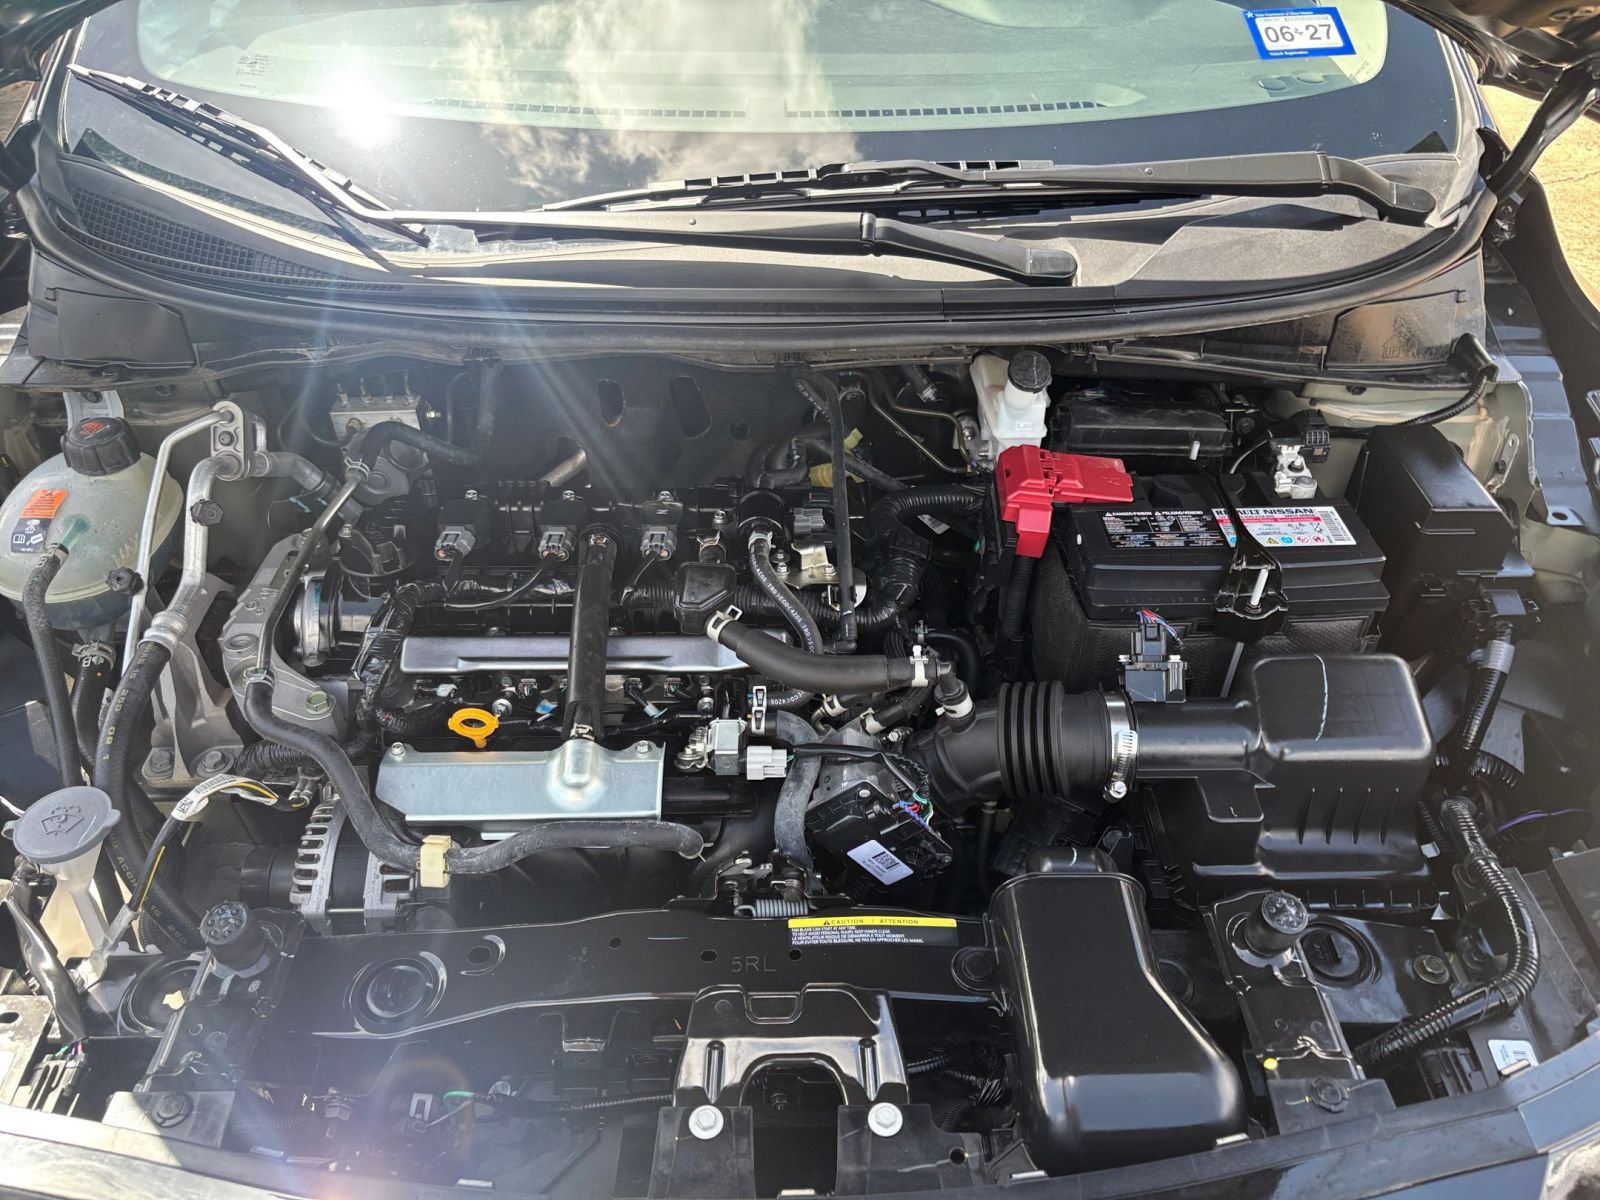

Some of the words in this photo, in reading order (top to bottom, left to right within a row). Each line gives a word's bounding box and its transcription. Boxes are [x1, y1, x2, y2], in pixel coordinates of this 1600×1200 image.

[1264, 26, 1295, 43] 06
[1305, 24, 1331, 41] 27
[82, 656, 92, 667] B
[731, 955, 776, 973] 5RL
